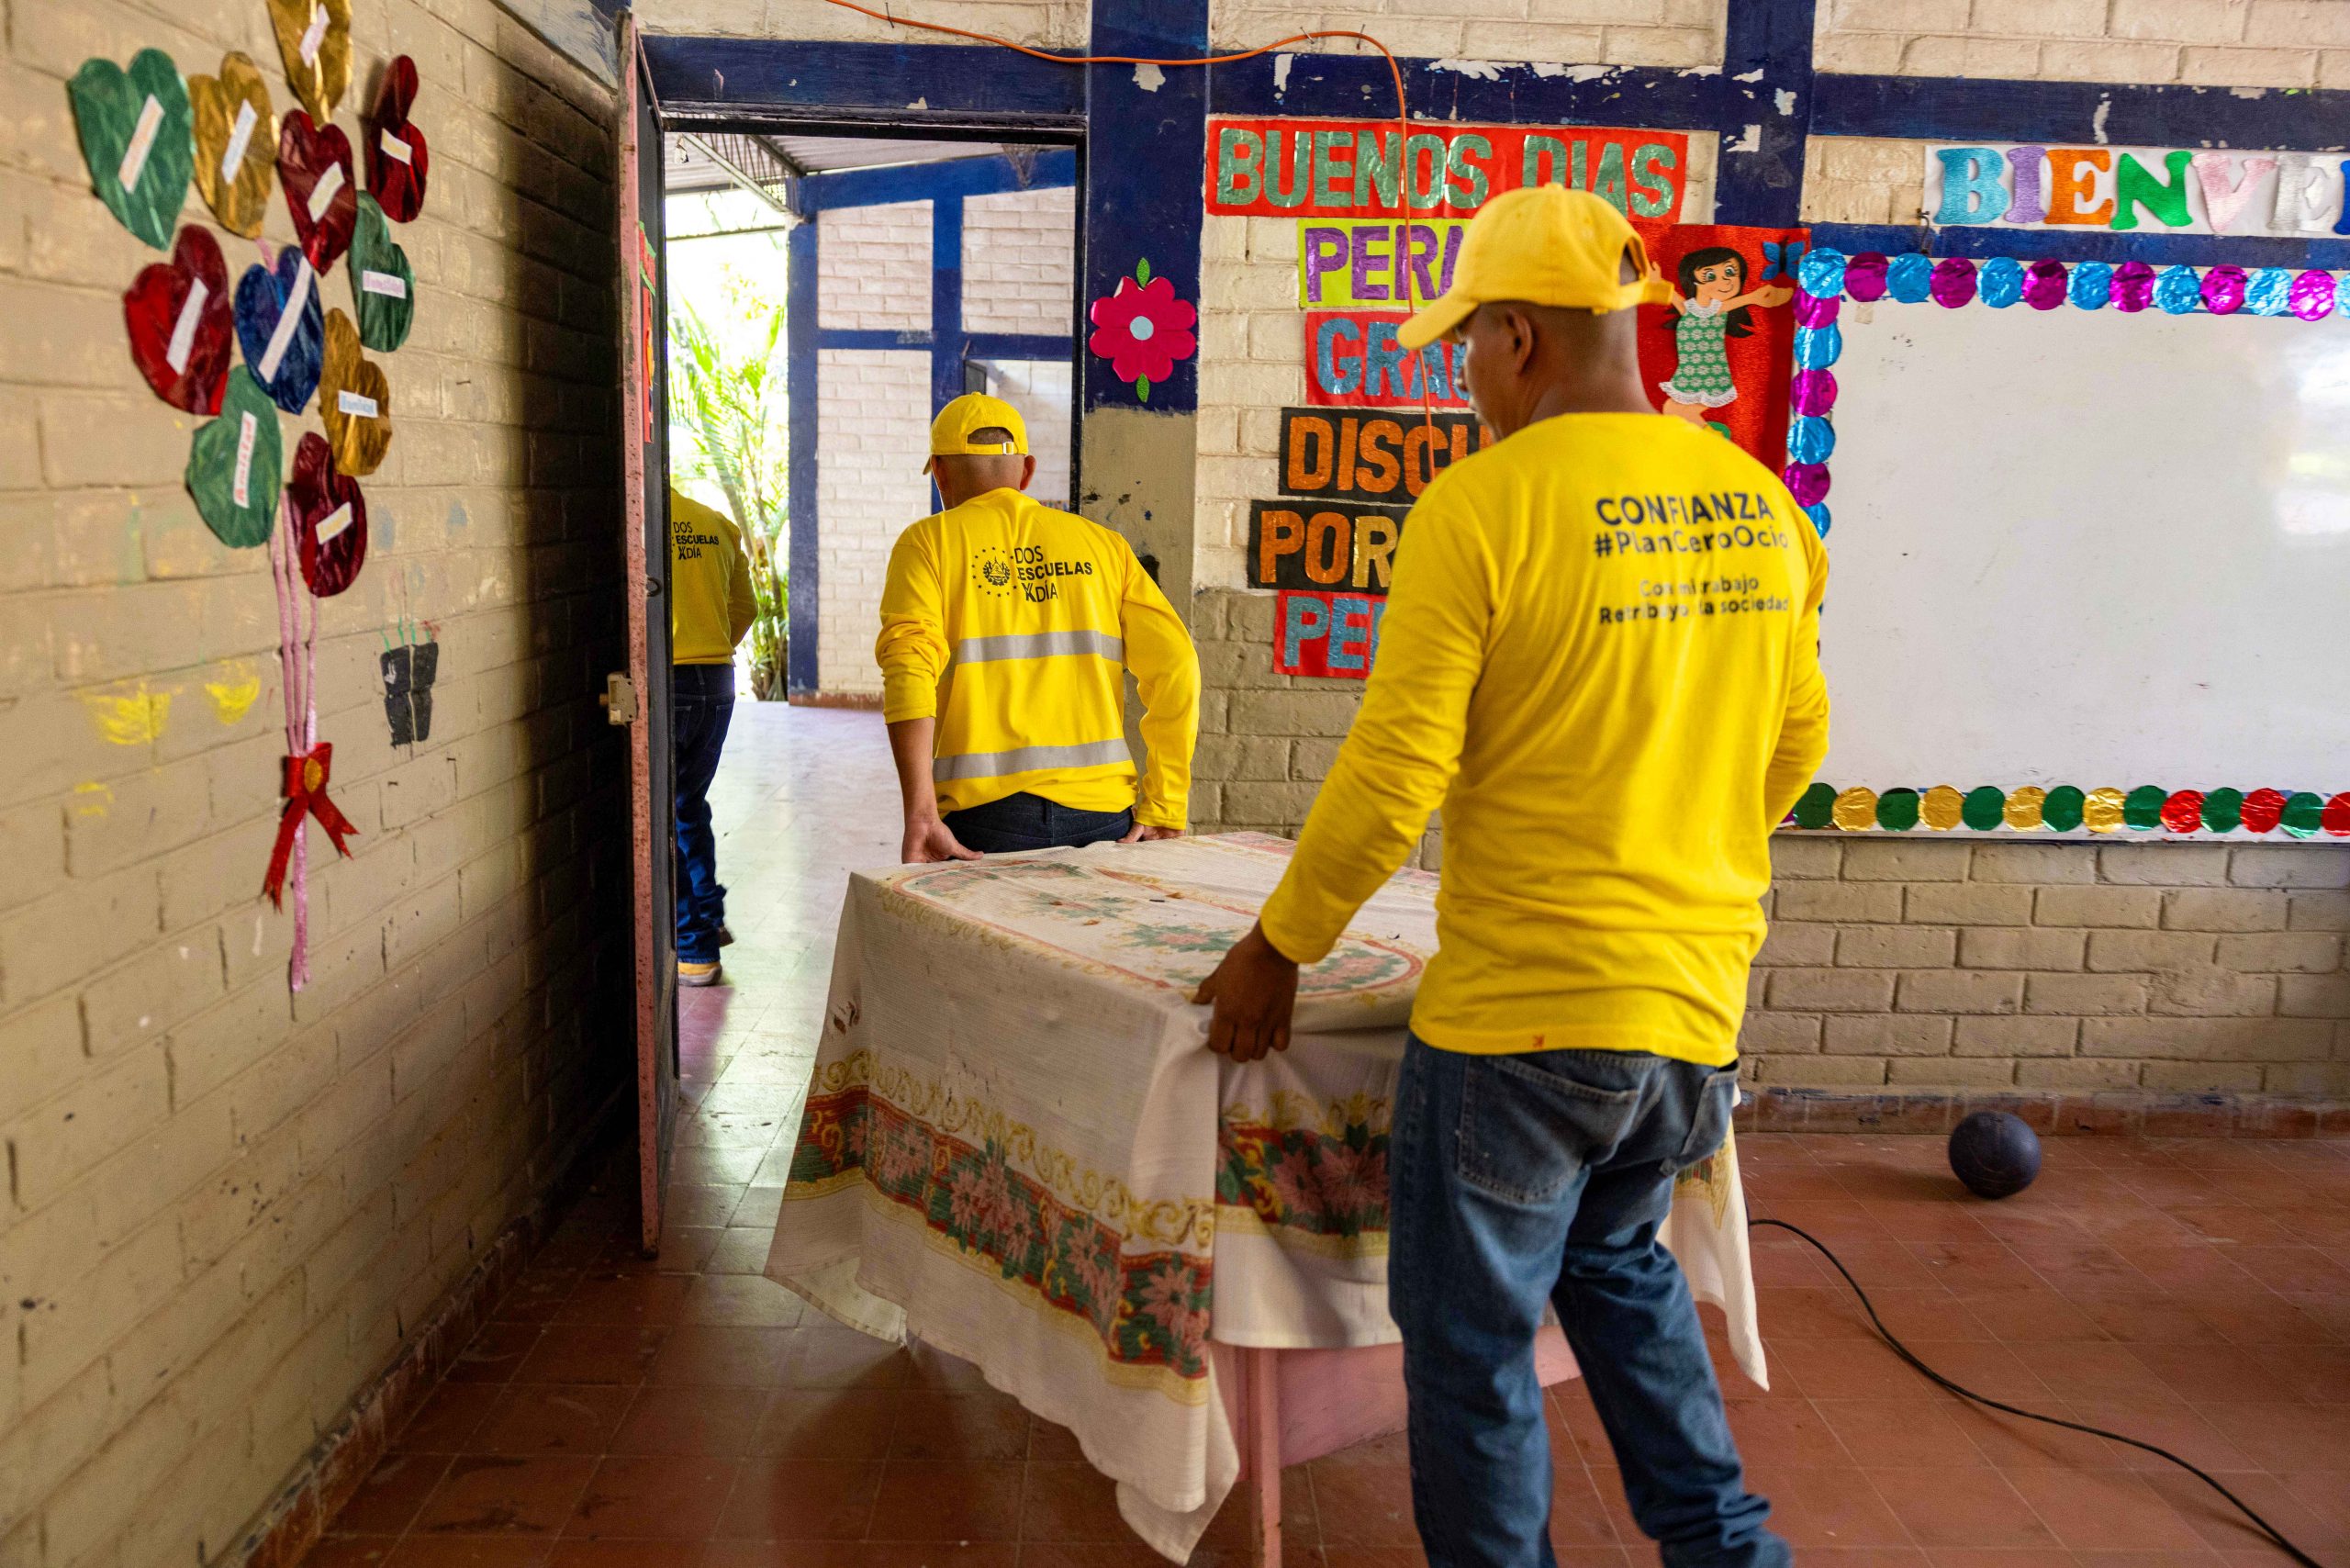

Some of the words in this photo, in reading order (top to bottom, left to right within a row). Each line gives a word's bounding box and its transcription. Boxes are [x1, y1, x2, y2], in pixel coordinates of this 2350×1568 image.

[1216, 127, 1493, 209] BUENOS
[1521, 134, 1677, 218] DIAS
[1933, 145, 2350, 235] BIENVE
[1595, 492, 1774, 526] CONFIANZA
[674, 521, 693, 533] DOS
[676, 534, 720, 545] ESCUELAS
[1595, 525, 1788, 557] #PlanCeroOcio
[1014, 545, 1044, 564] DOS
[1259, 510, 1398, 588] POR
[1017, 561, 1093, 580] ESCUELAS
[1700, 573, 1760, 595] rabajo
[1283, 596, 1388, 670] PE
